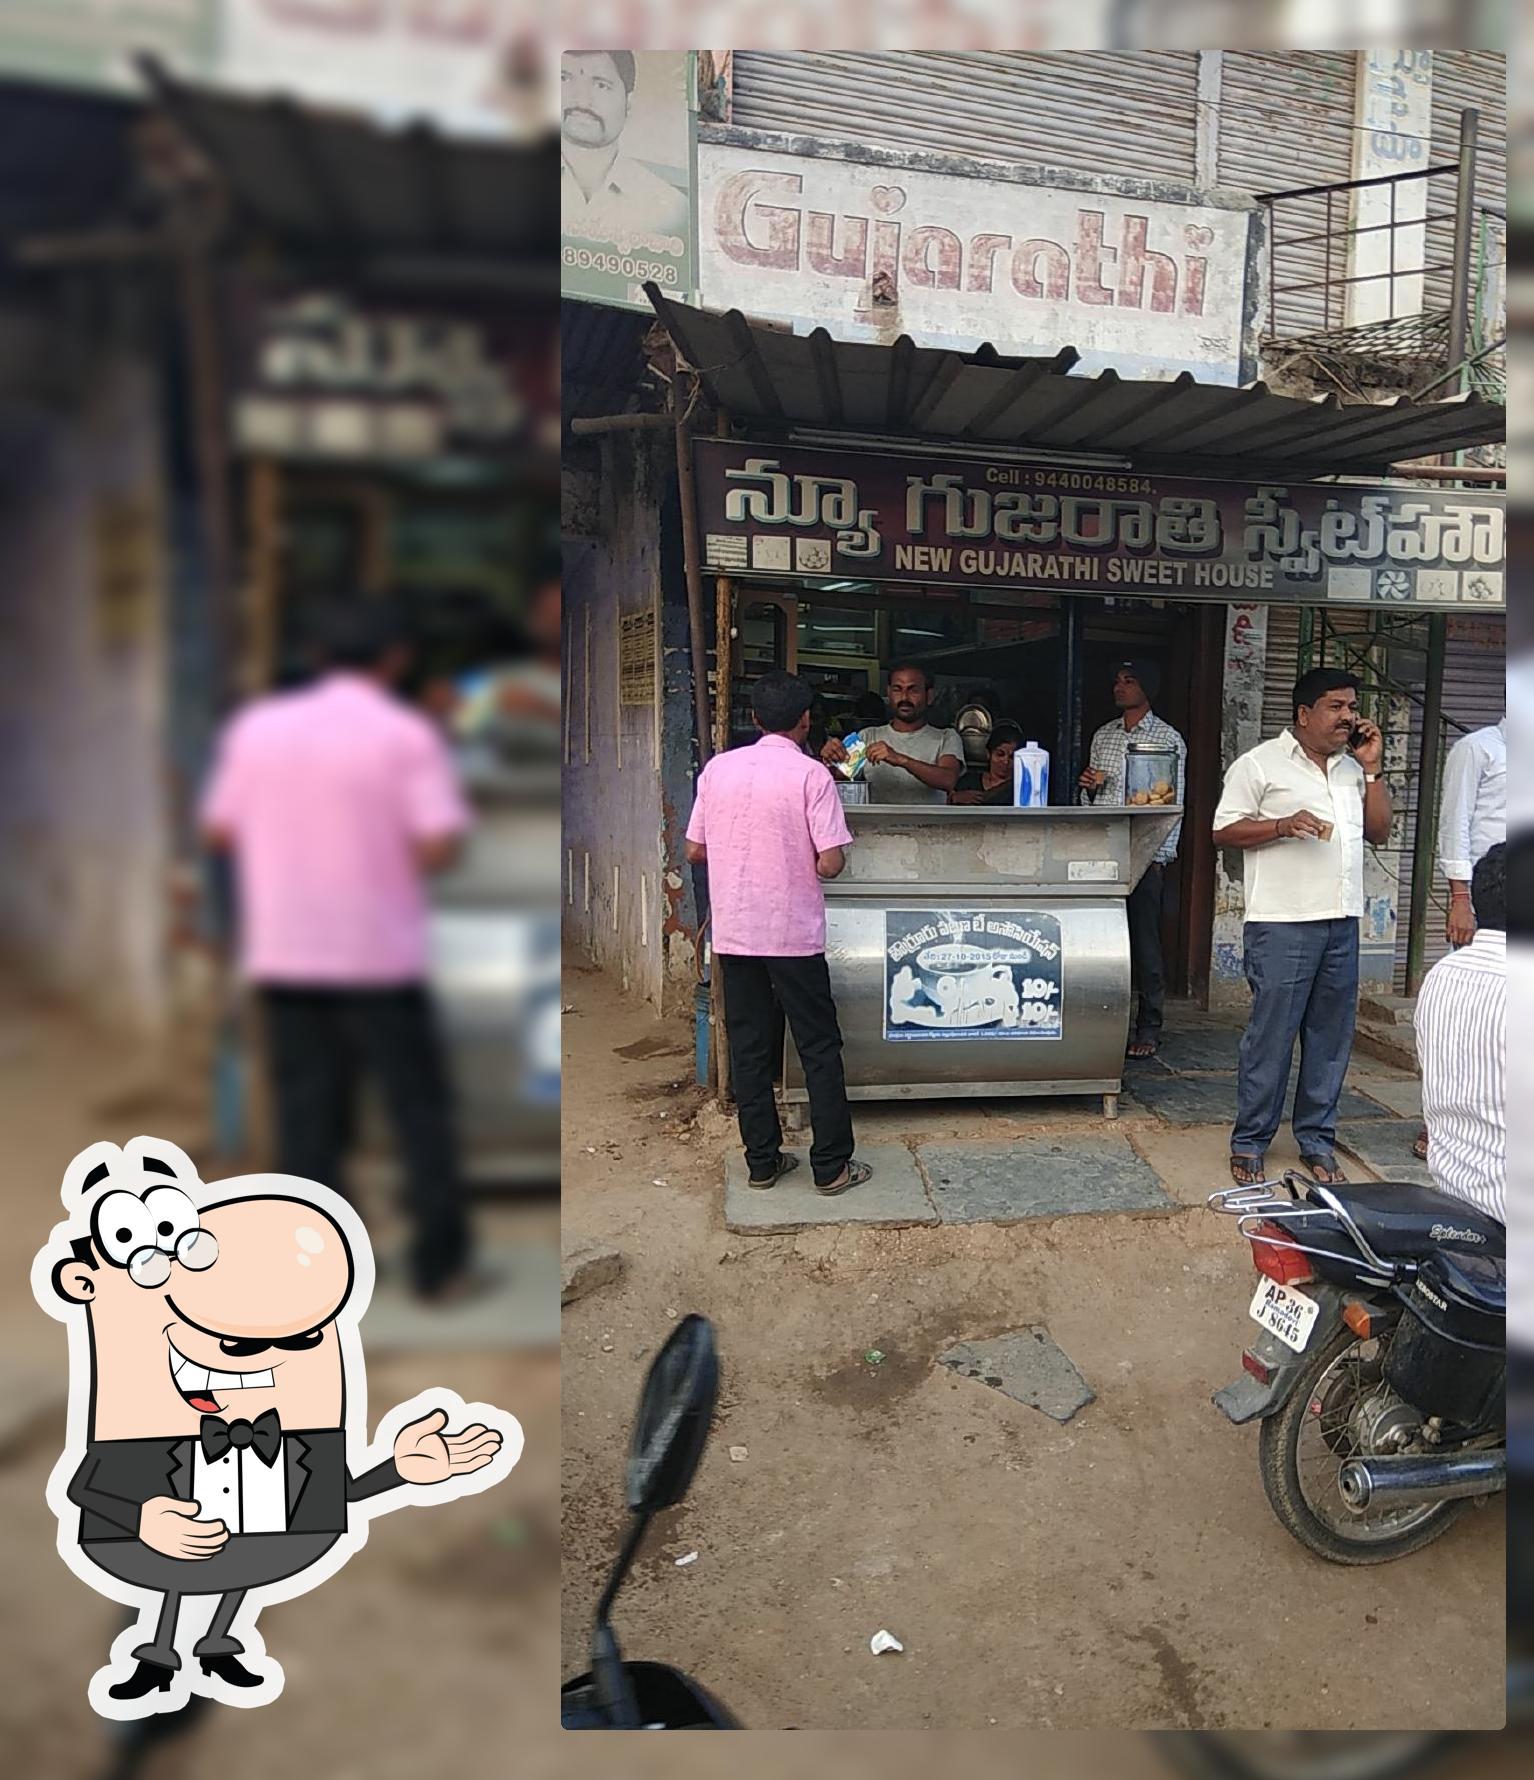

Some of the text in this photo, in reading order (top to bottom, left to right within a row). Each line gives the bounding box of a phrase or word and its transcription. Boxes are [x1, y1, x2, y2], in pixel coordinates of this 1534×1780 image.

[562, 246, 677, 284] 89490528
[714, 169, 1214, 323] Gujarathi
[986, 467, 1020, 486] Cell
[725, 458, 881, 557] న్యూ
[906, 474, 1221, 552] గుజరాతి
[895, 545, 1274, 589] NEW GUJARATHI SWEET HOUSE
[1265, 1285, 1303, 1319] AP 36
